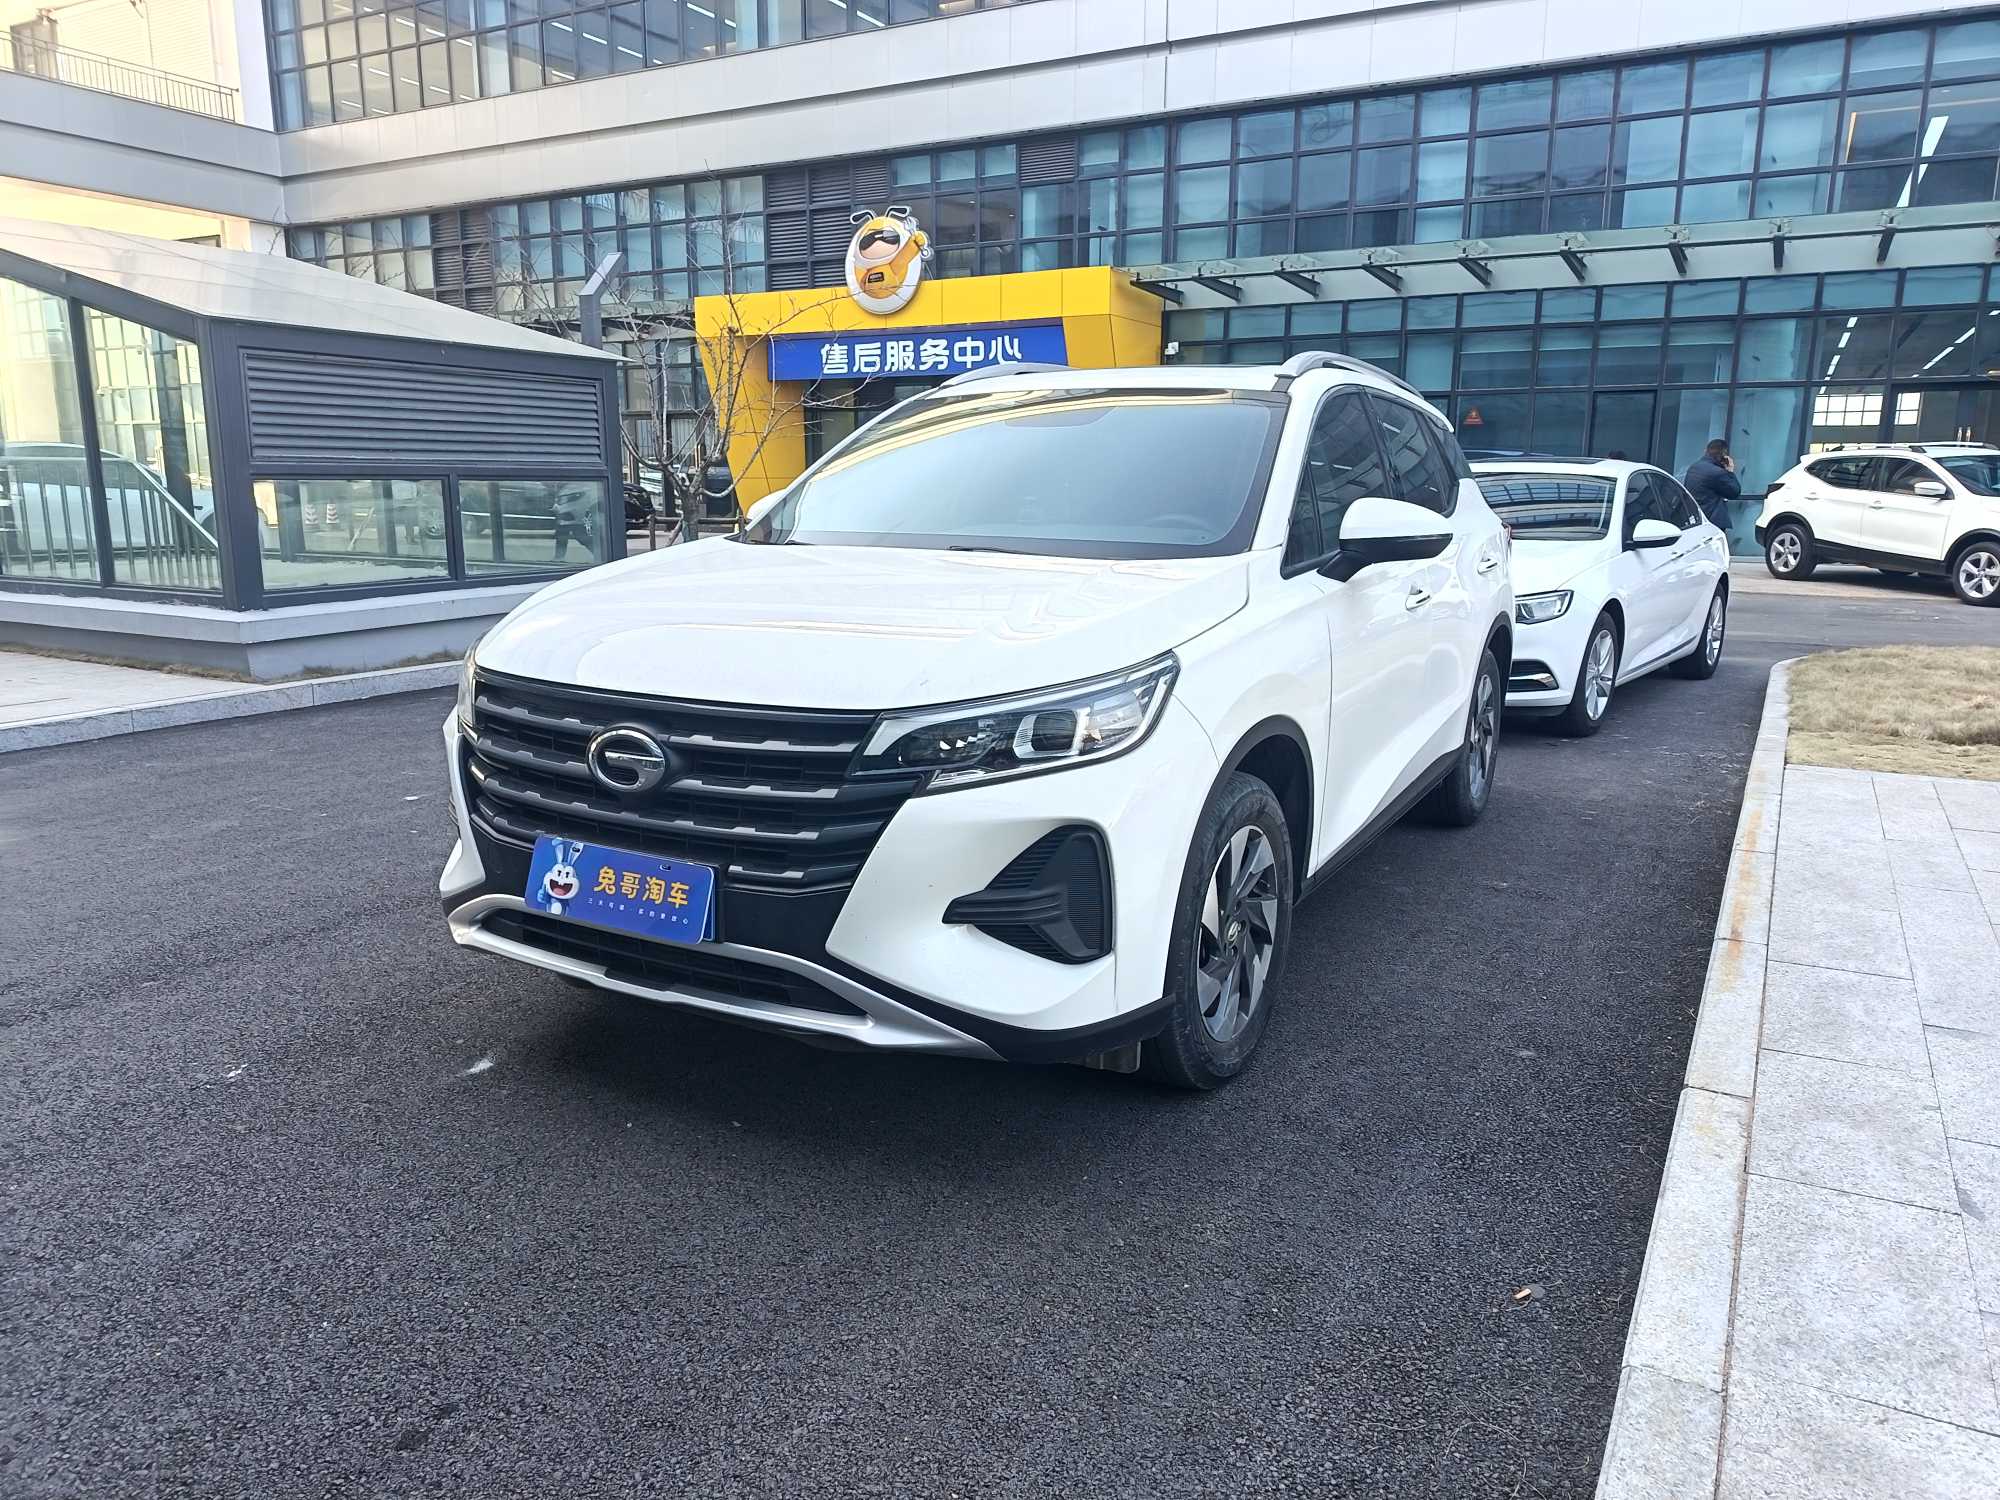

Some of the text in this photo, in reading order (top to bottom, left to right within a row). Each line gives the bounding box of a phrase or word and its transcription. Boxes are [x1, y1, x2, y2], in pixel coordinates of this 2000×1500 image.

[820, 335, 1022, 375] 售后服务中心
[593, 865, 690, 909] 兔哥淘车
